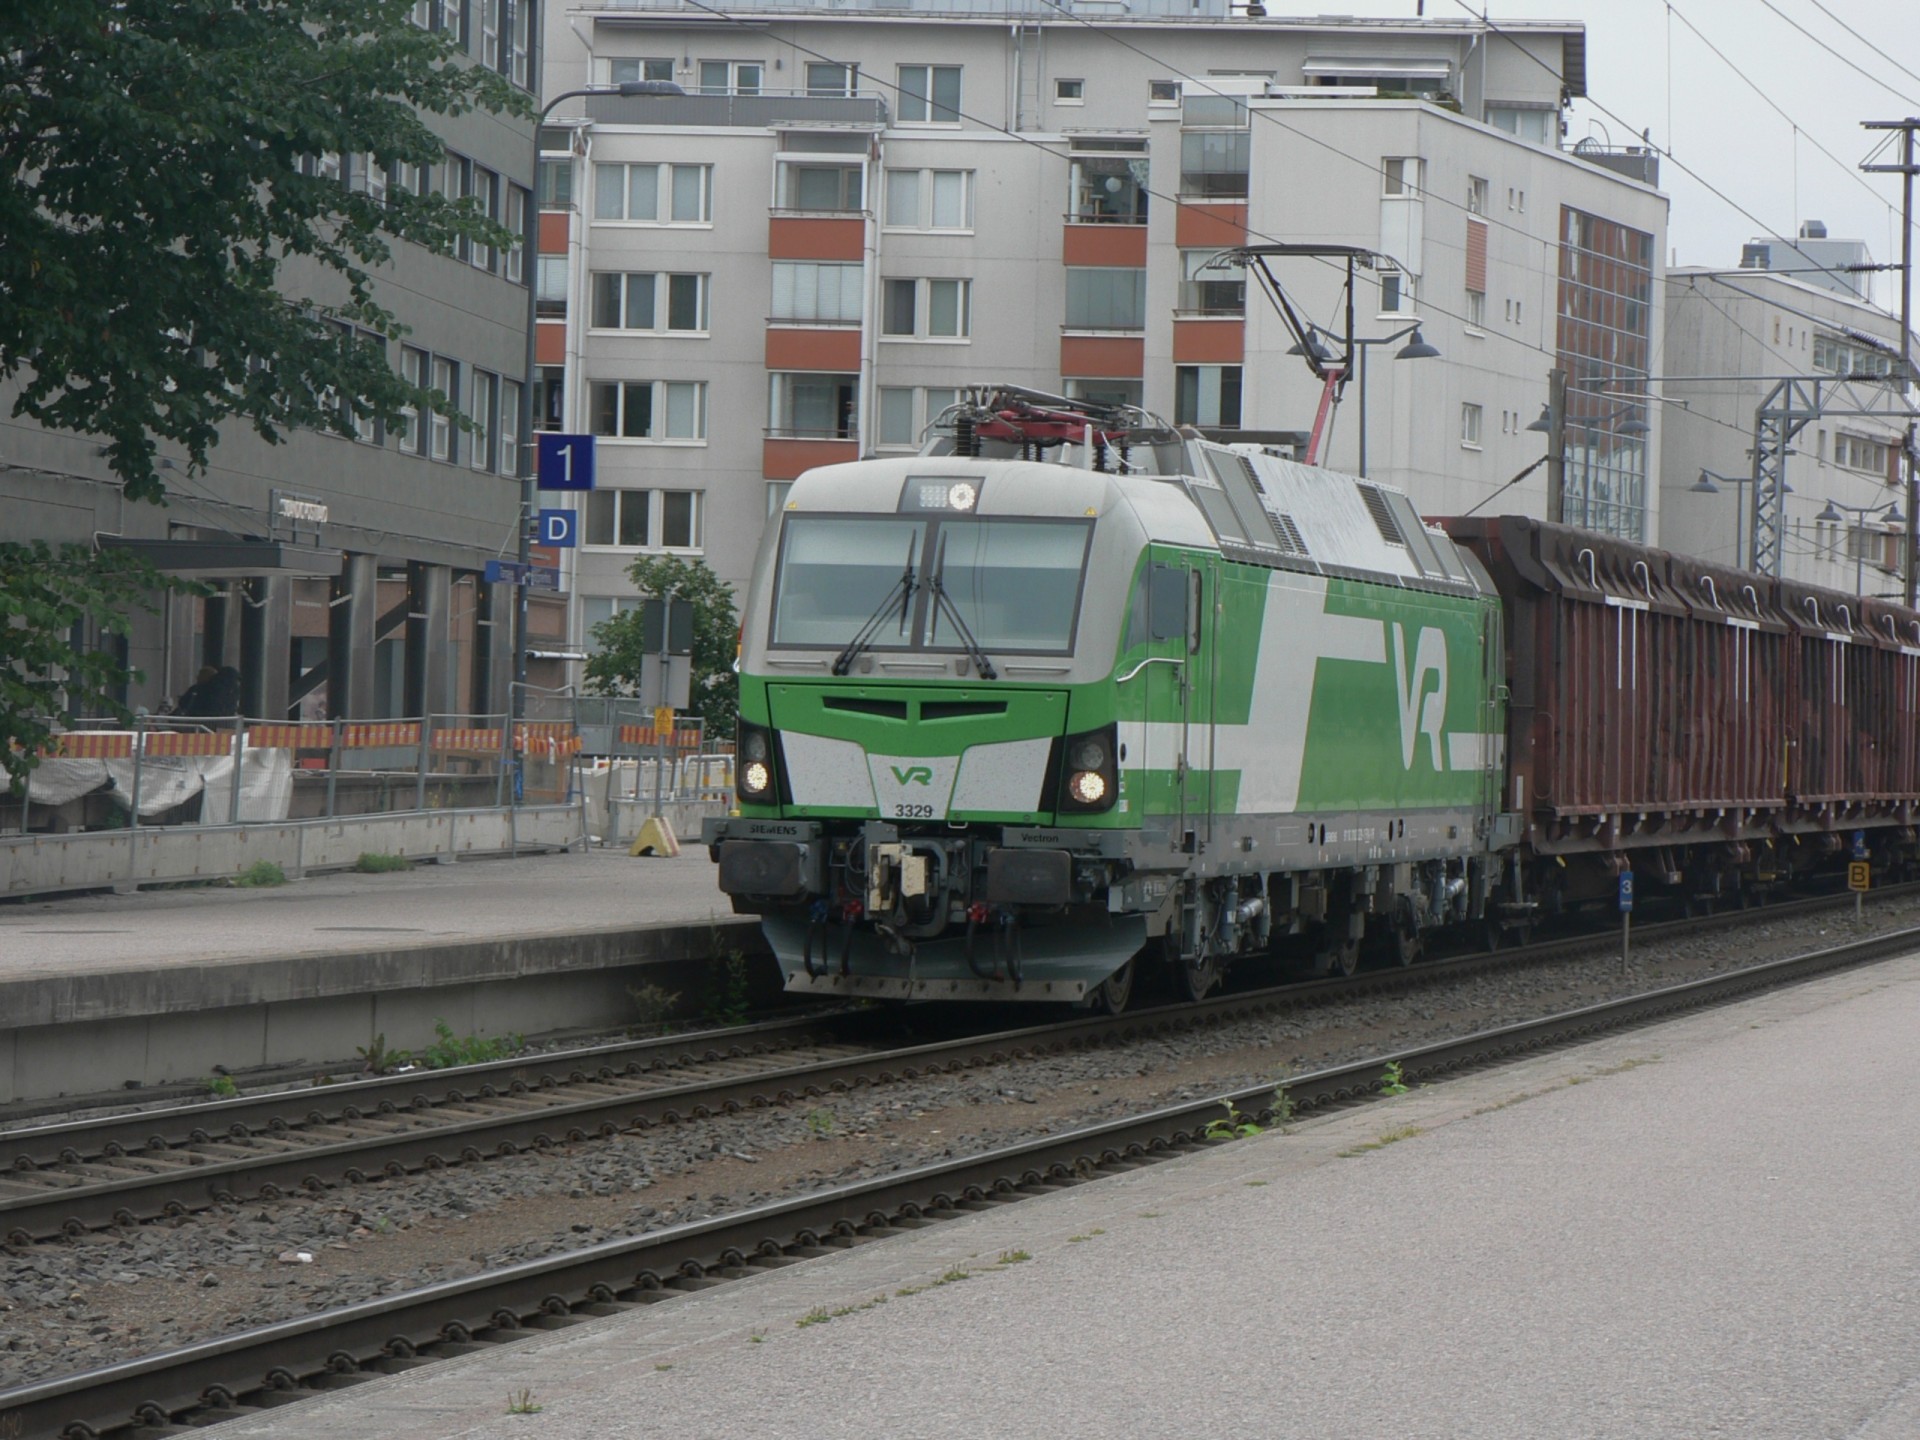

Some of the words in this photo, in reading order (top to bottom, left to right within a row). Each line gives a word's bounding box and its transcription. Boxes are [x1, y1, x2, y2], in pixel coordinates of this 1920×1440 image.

[557, 444, 572, 481] 1
[548, 517, 568, 540] D
[1392, 622, 1448, 771] VR
[890, 766, 932, 785] VR
[895, 804, 933, 818] 3329
[749, 824, 797, 835] SIEMENS
[1021, 832, 1059, 843] Vectron
[1856, 838, 1864, 848] 4
[1852, 866, 1865, 882] B
[1622, 879, 1632, 894] 3
